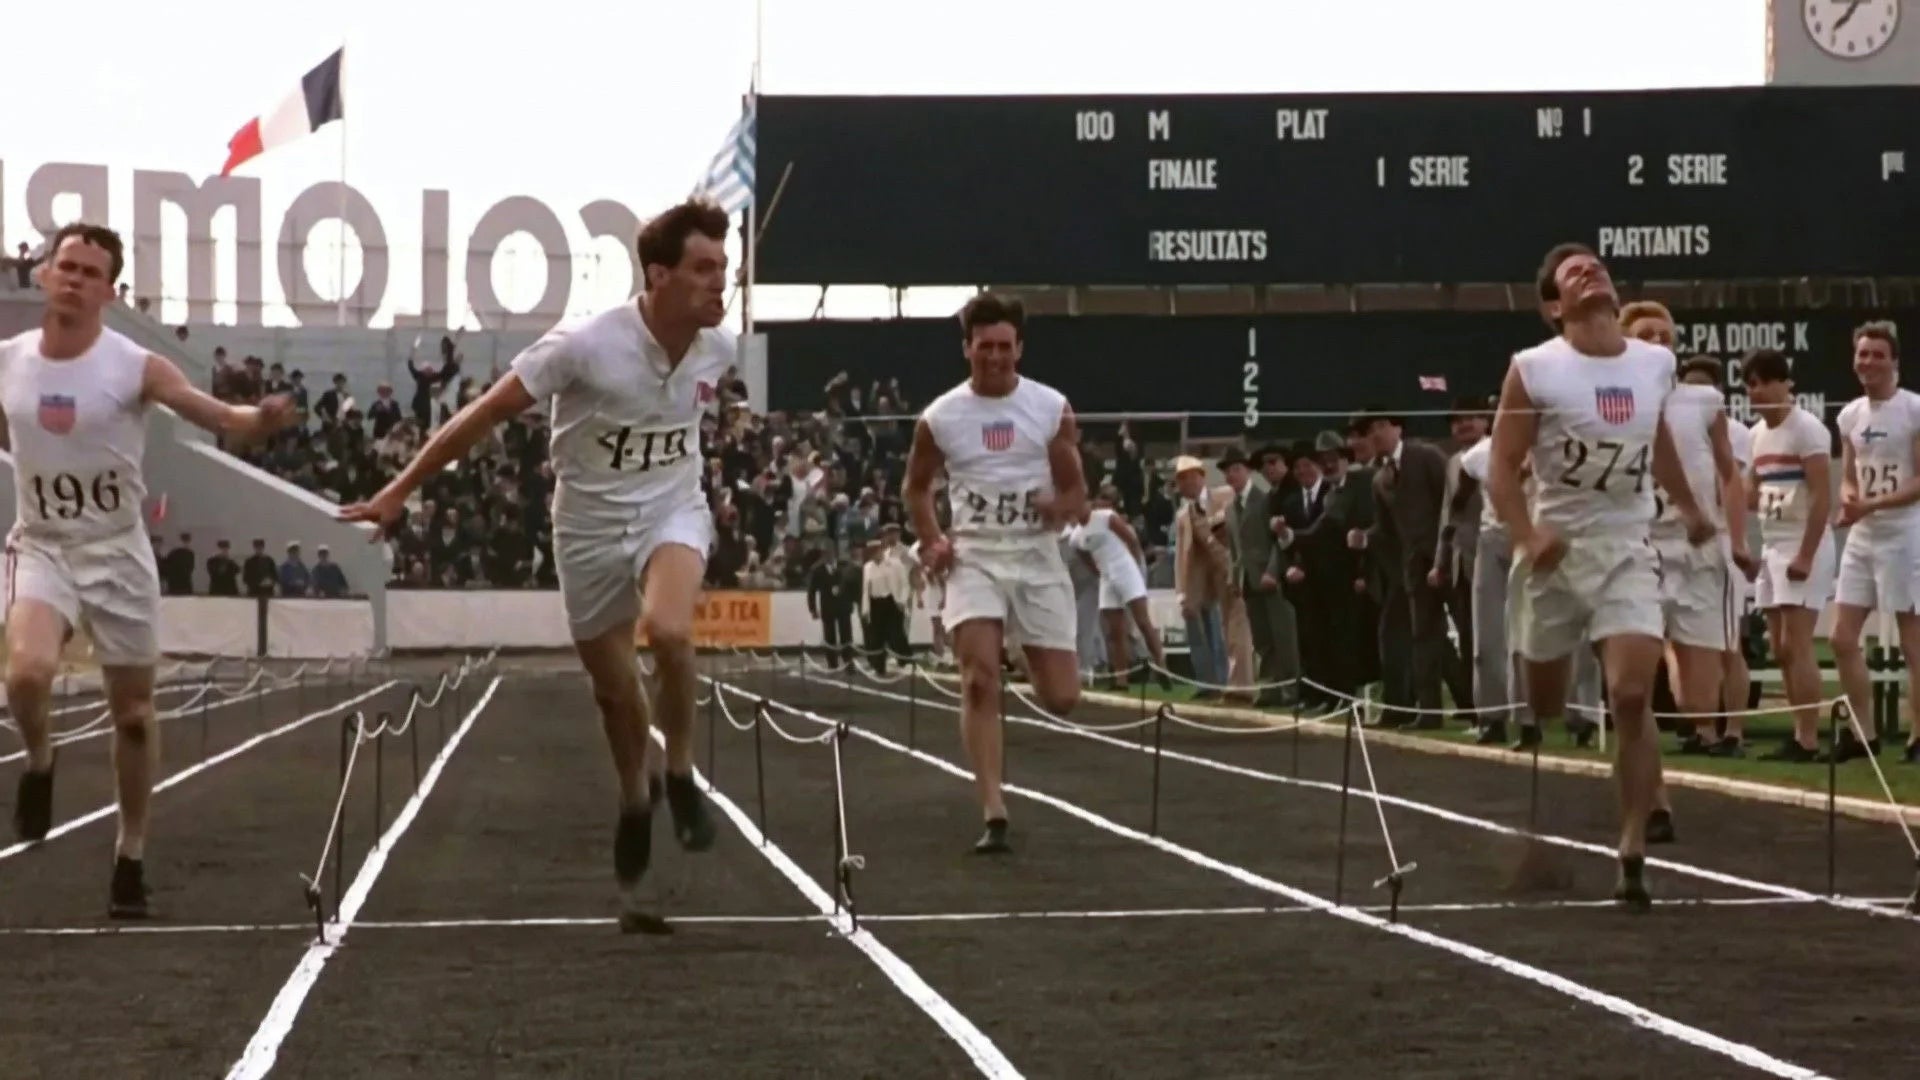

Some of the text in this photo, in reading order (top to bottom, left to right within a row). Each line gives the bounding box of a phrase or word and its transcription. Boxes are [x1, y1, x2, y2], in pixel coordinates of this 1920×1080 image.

[1076, 110, 1115, 141] 100
[1148, 110, 1170, 141] M
[1276, 109, 1329, 140] PLAT
[1148, 158, 1218, 190] FINALE
[1409, 156, 1470, 187] SERIE
[1628, 154, 1644, 185] 2
[1667, 153, 1728, 185] SERIE
[1149, 229, 1268, 261] RESULTATS
[1599, 225, 1710, 257] PARTANTS
[1244, 361, 1259, 391] 2
[1244, 397, 1259, 428] 3
[1560, 438, 1649, 494] 274
[32, 469, 121, 520] 196
[729, 601, 761, 621] TEA
